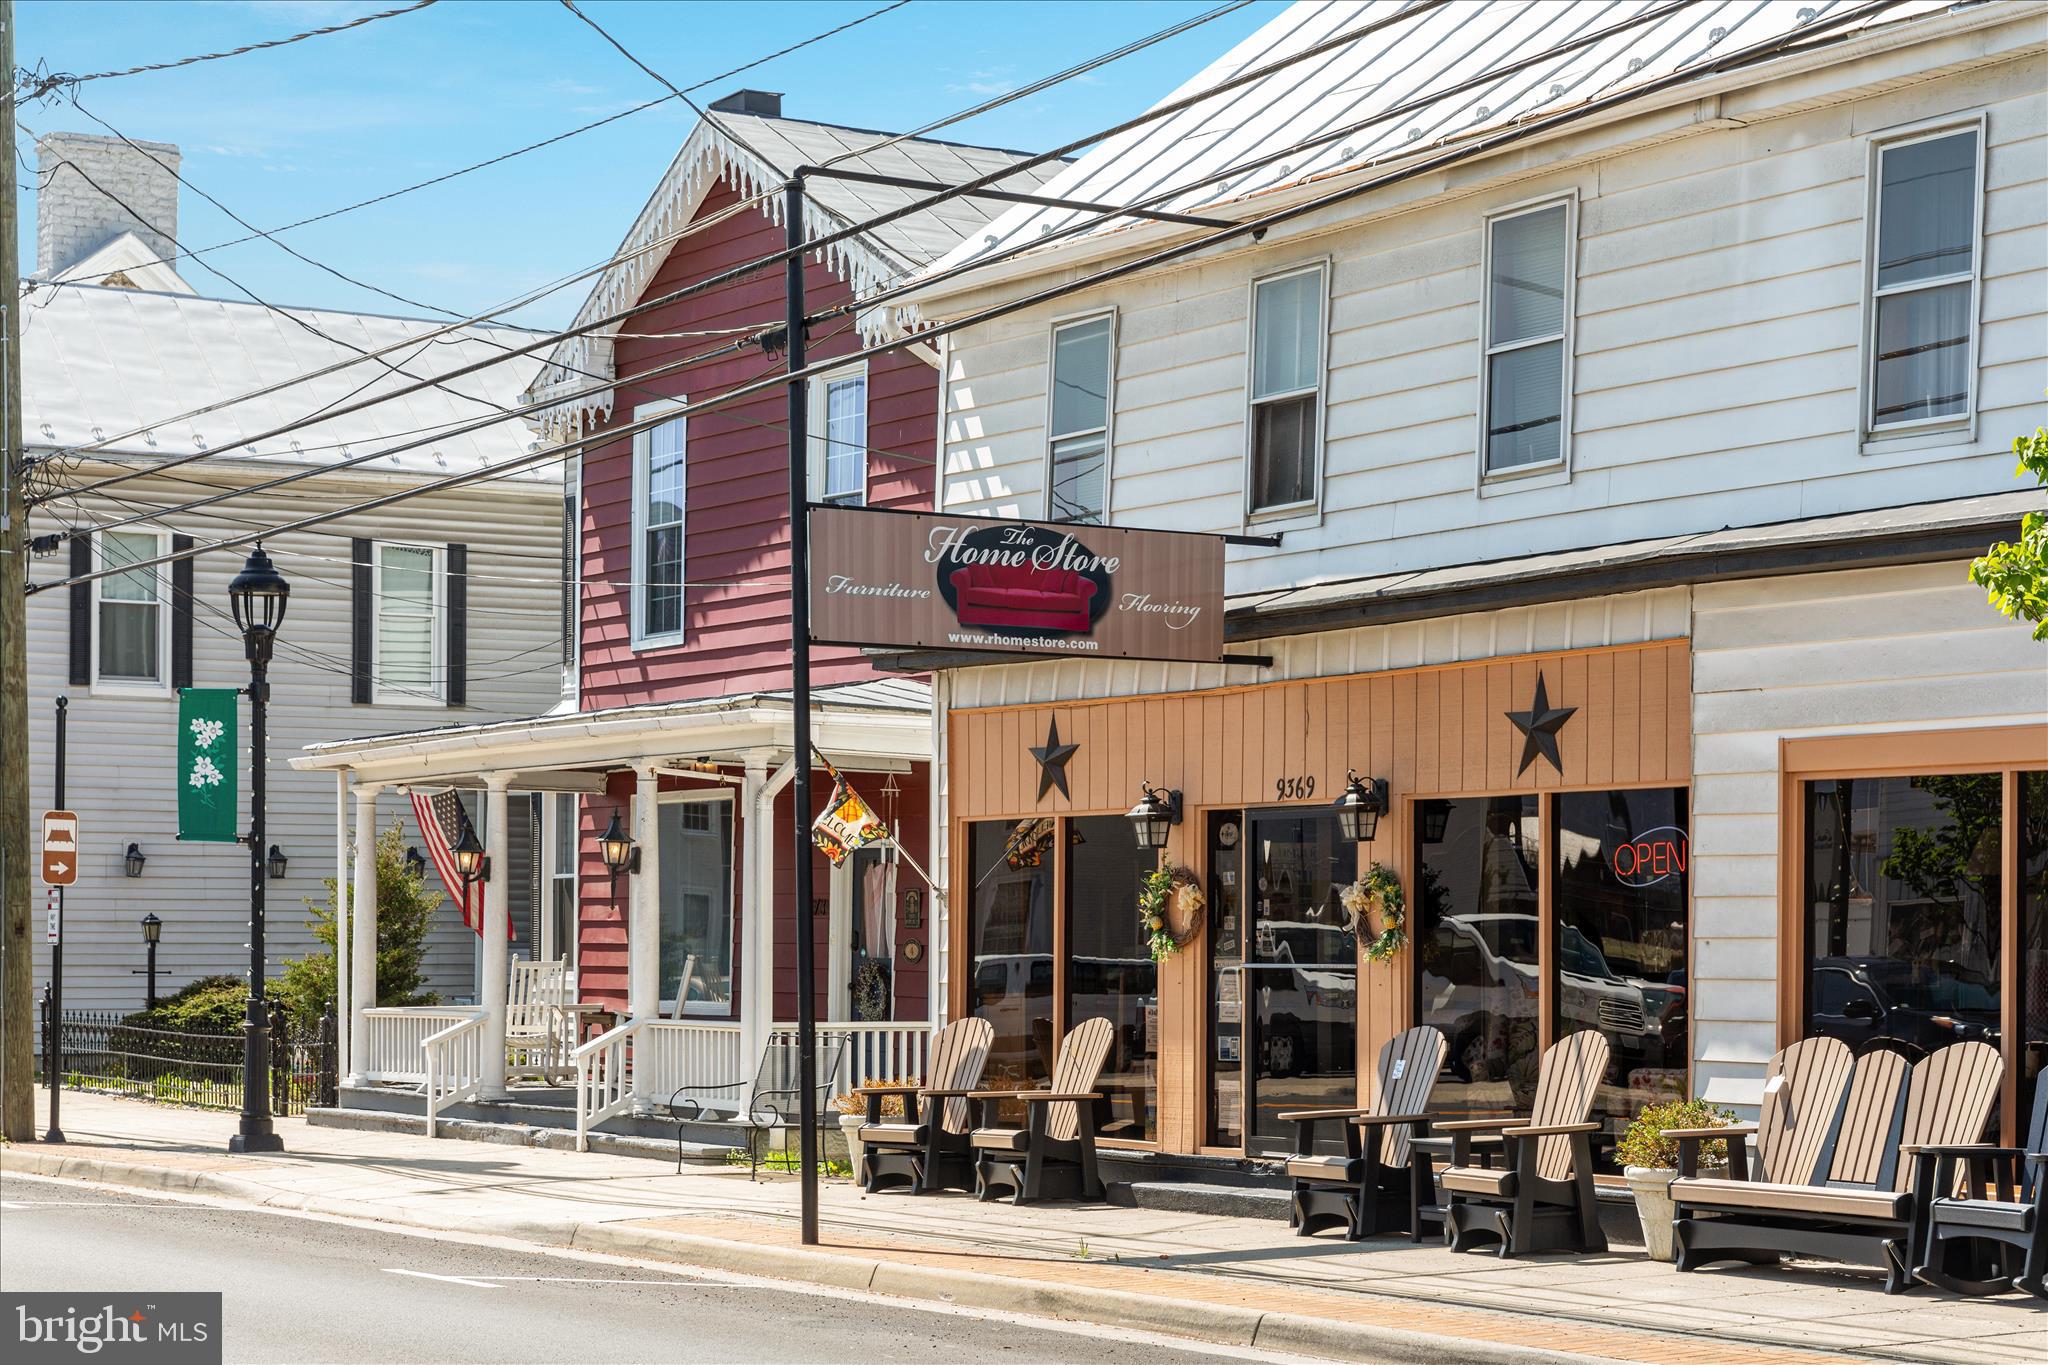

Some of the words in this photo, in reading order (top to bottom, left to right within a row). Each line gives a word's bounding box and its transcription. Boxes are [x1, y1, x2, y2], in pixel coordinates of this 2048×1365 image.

[1000, 526, 1035, 546] The
[924, 525, 1027, 568] Home
[1030, 532, 1121, 576] Store
[825, 574, 931, 599] Furniture
[1118, 593, 1201, 630] Flooring
[948, 633, 1099, 650] www.rhomestore.com
[1276, 775, 1315, 801] 9369
[1614, 839, 1686, 876] OPEN
